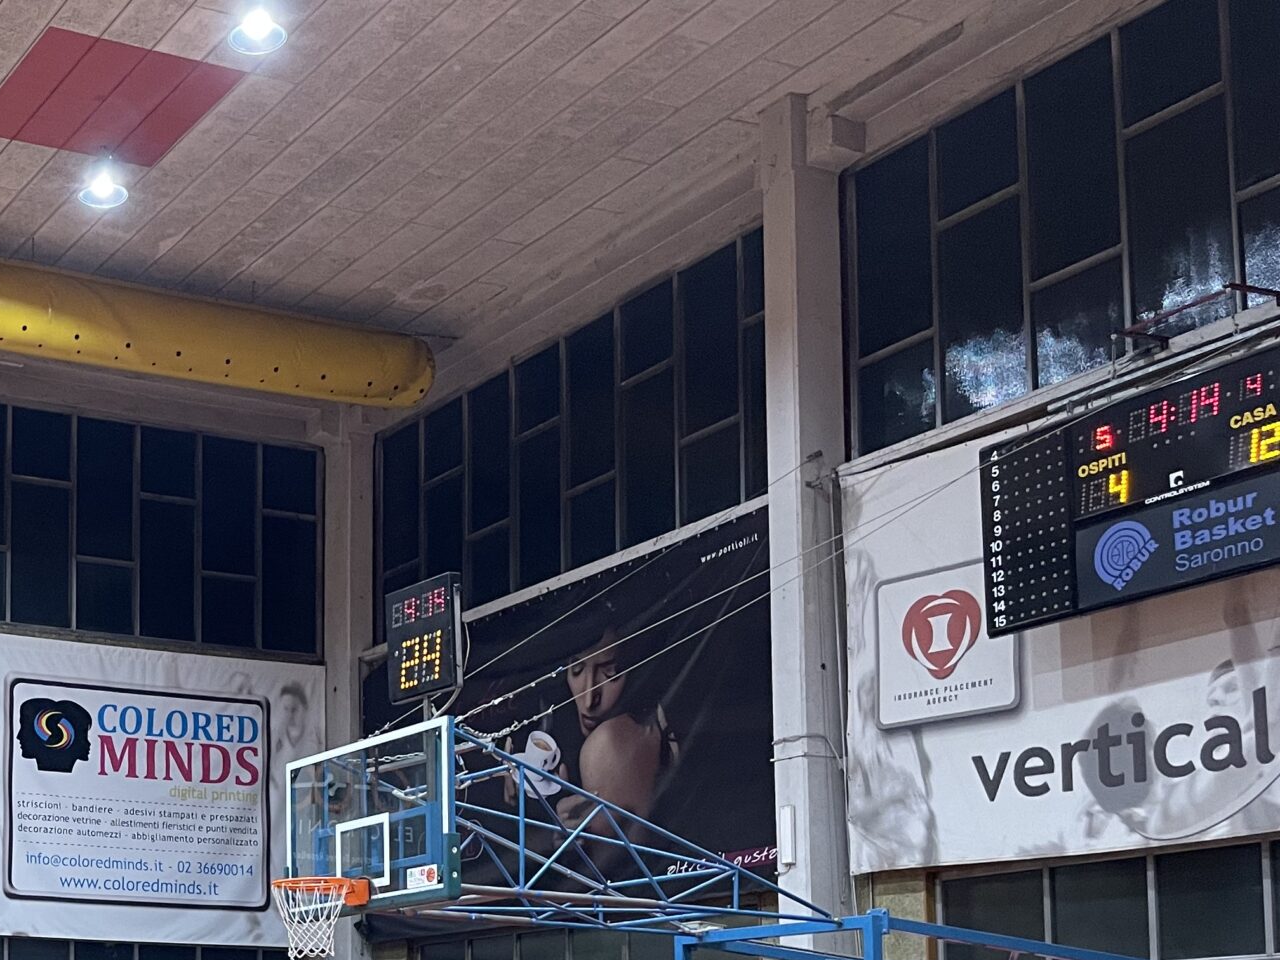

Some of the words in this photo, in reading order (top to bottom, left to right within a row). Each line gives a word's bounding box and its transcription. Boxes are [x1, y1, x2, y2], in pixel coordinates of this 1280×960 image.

[1229, 403, 1277, 429] CASA
[990, 450, 998, 461] 4
[1078, 452, 1127, 478] OSPITI
[991, 466, 999, 477] 5
[991, 481, 1000, 492] 6
[992, 495, 1001, 507] 7
[1172, 492, 1258, 529] Robur
[993, 510, 1001, 522] 8
[993, 524, 1002, 536] 9
[1174, 507, 1276, 551] Basket
[990, 540, 1003, 553] 10
[1175, 537, 1264, 572] Saronno
[990, 555, 1002, 568] 11
[1112, 539, 1160, 591] ROBUR
[991, 569, 1005, 583] 12
[992, 584, 1006, 598] 13
[993, 599, 1006, 613] 14
[993, 615, 1007, 628] 15
[401, 629, 442, 690] 24
[944, 678, 993, 693] PLACEMENT
[926, 694, 959, 706] AGENCY
[97, 704, 259, 744] COLORED
[971, 686, 1275, 802] vertical
[98, 734, 260, 786] MINDS
[169, 785, 207, 800] digital
[211, 789, 258, 805] printing
[17, 800, 62, 810] striscioni
[71, 803, 113, 814] bandiere
[124, 807, 156, 817] adesivi
[159, 810, 198, 820] stampati
[209, 814, 258, 824] prespaziati
[17, 811, 70, 823] decorazione
[72, 815, 102, 826] vetrine
[206, 825, 227, 834] punti
[229, 827, 258, 835] vendita
[17, 823, 74, 836] decorazione
[76, 828, 122, 839] automezzi
[131, 831, 194, 844] abbigliamento
[197, 837, 259, 847] personalizzato
[25, 851, 164, 873] info@coloredminds.it
[177, 861, 192, 874] 02
[196, 861, 254, 877] 36690014
[59, 874, 219, 896] www.coloredminds.it
